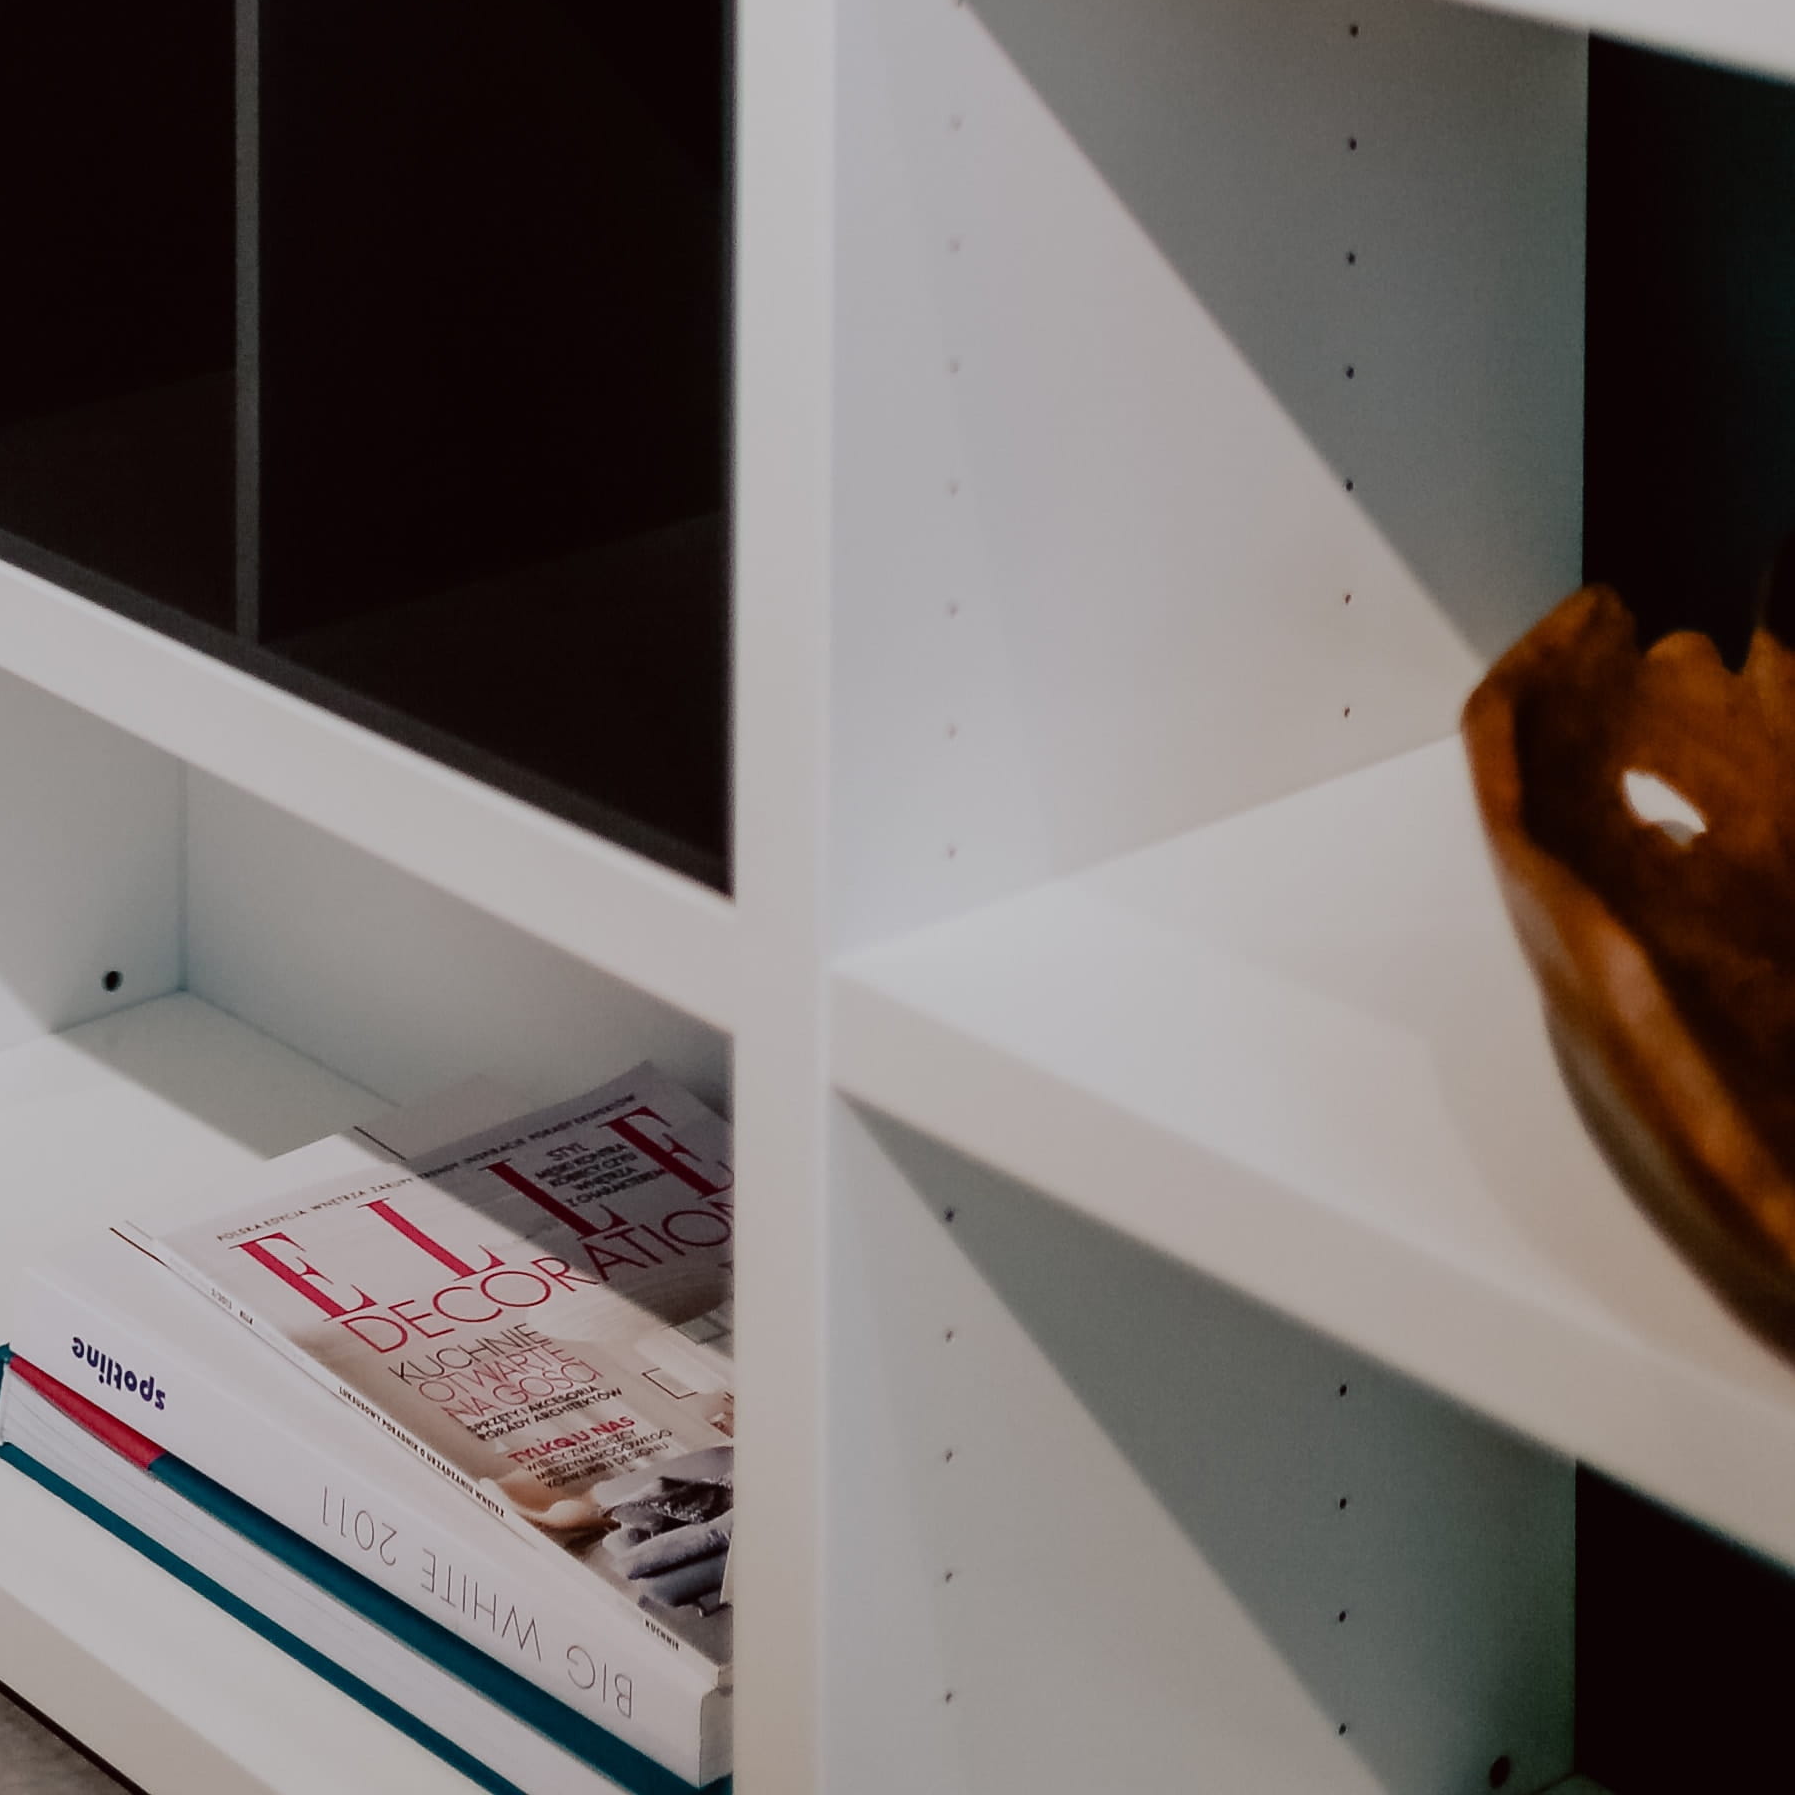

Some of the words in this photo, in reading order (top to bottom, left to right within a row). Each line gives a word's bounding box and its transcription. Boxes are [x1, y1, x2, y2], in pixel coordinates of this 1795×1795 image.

[547, 1142, 587, 1160] STYL
[228, 1105, 734, 1320] ELLE
[71, 1336, 166, 1411] spotline
[388, 1322, 547, 1386] KUCHNIE
[419, 1341, 576, 1402] OTWARTE
[338, 1386, 382, 1424] LUKSUSOWY
[381, 1418, 418, 1452] PORADNIK
[442, 1395, 495, 1427] NA
[477, 1416, 535, 1442] PORADY
[534, 1387, 623, 1425] ARCHITEKTÓW
[528, 1385, 599, 1412] AKCESORIA
[590, 1415, 636, 1440] NAS
[320, 1486, 398, 1566] 2011
[420, 1548, 542, 1663] WHITE
[566, 1644, 633, 1719] BIG
